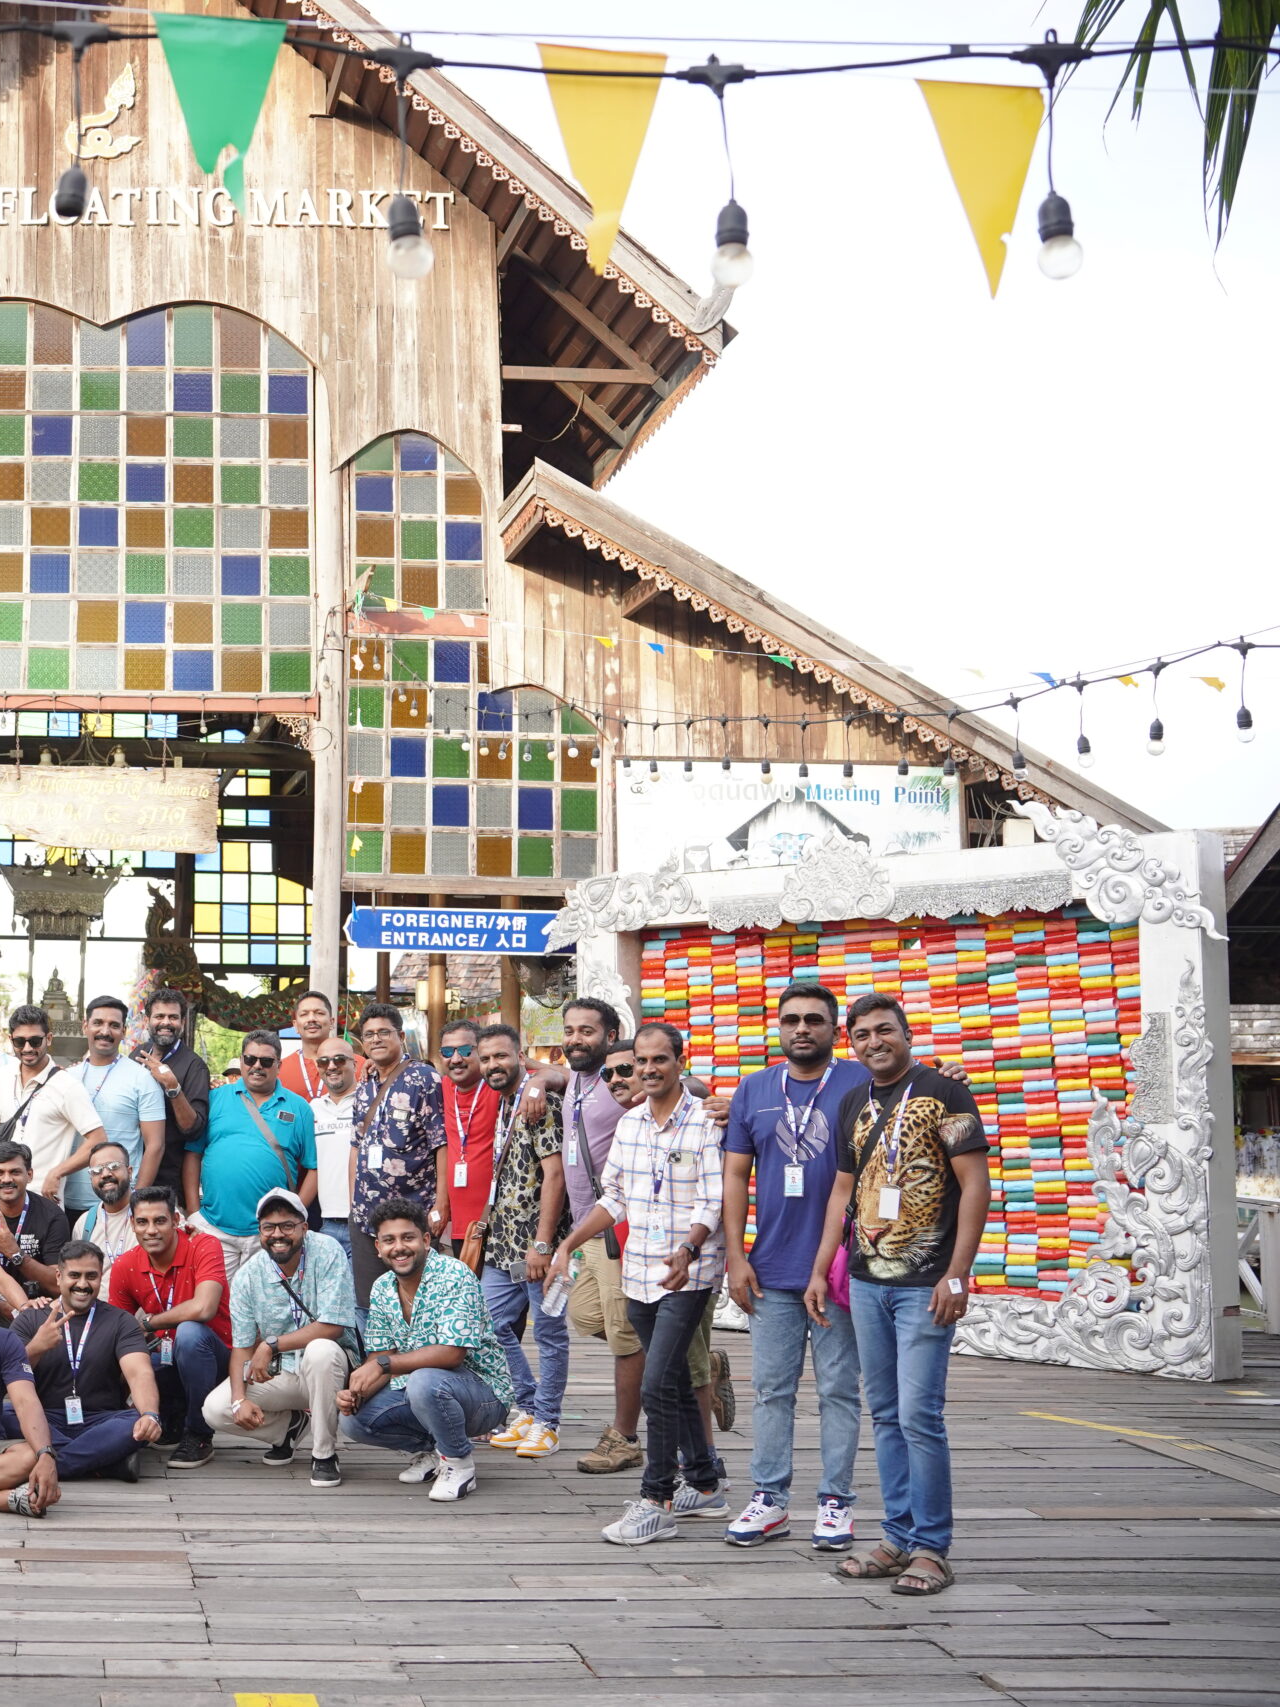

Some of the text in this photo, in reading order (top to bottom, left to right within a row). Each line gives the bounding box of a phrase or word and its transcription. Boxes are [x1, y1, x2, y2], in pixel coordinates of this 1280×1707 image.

[805, 783, 880, 805] Meeting
[894, 785, 943, 805] Point
[381, 932, 527, 948] ENTRANCE/ 入口
